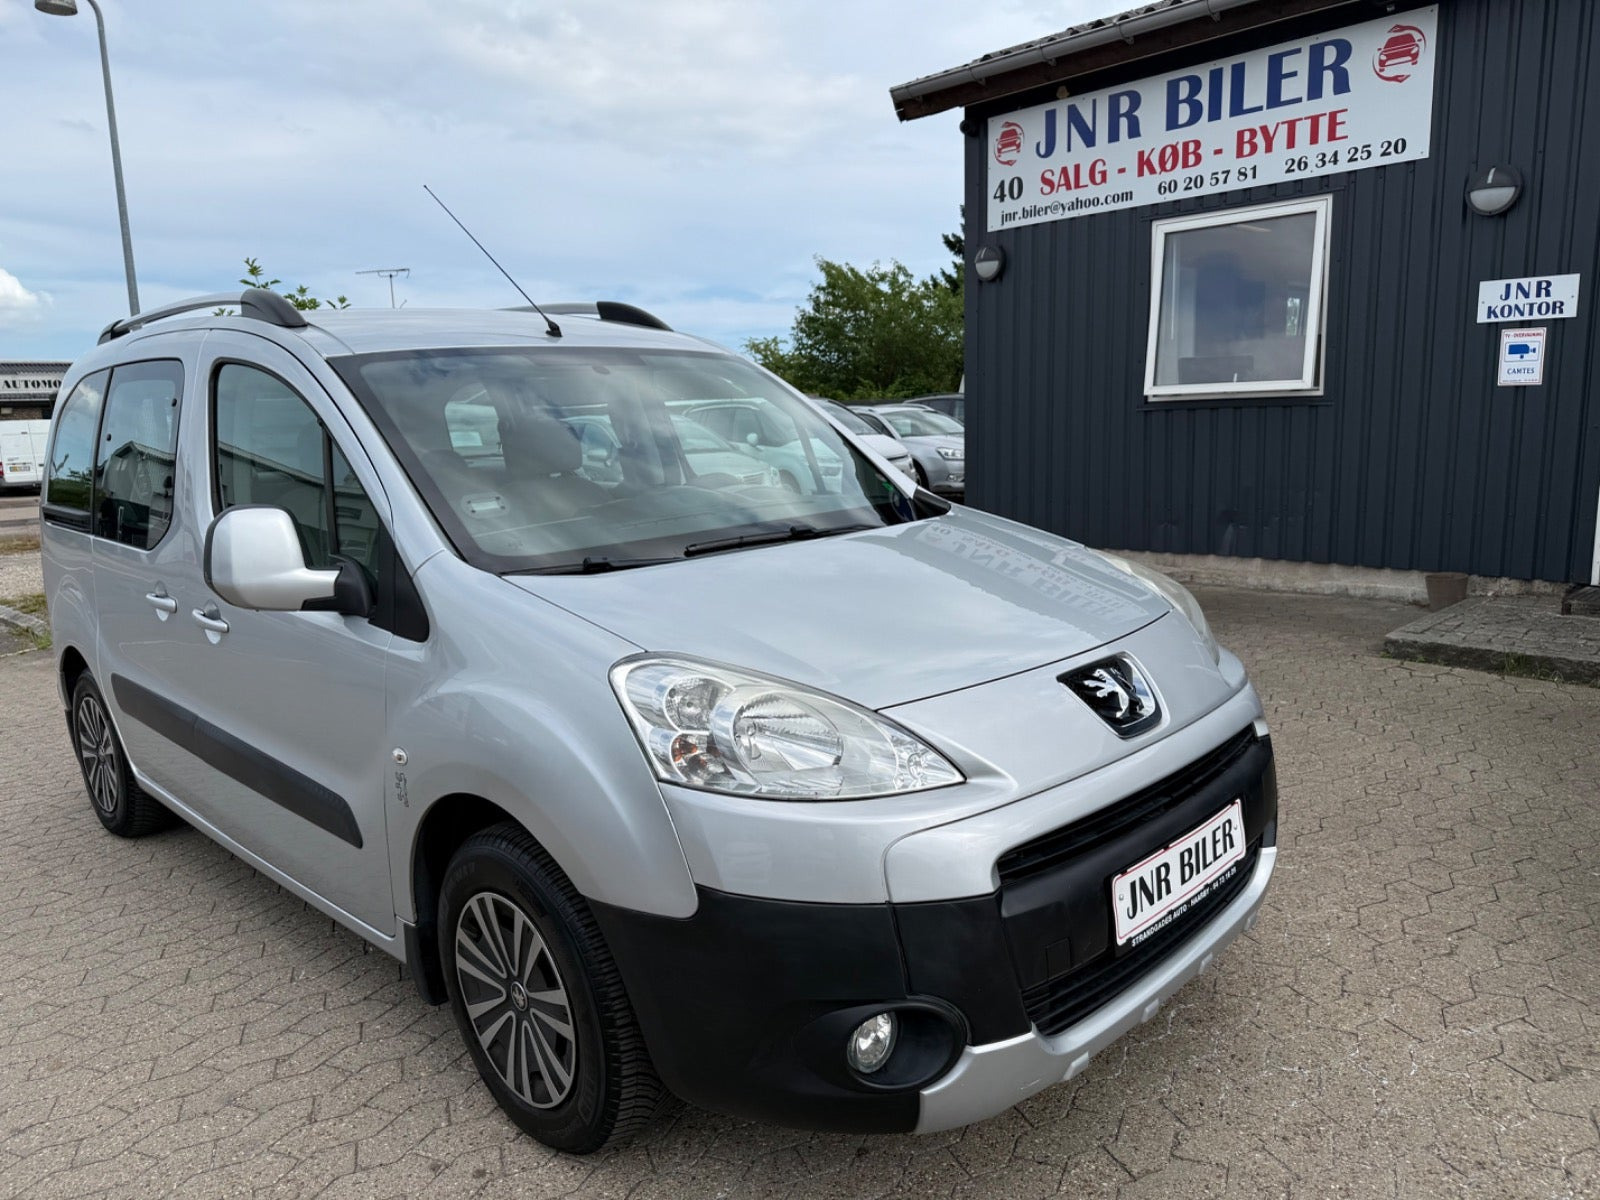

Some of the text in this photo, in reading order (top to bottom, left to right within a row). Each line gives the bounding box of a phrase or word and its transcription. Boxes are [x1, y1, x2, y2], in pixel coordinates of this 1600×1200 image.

[1035, 38, 1353, 159] JNR BILER
[1040, 108, 1349, 196] SALG - KØB - BYTTE
[1284, 137, 1407, 174] 26 34 25 20
[993, 176, 1024, 203] 40
[1158, 164, 1257, 196] 60 20 57 81
[1000, 190, 1134, 226] jnr.biler@yahoo.com
[1500, 279, 1553, 301] JNR
[1486, 300, 1565, 320] KONTOR
[1126, 818, 1235, 920] JNR BILER
[1173, 904, 1188, 919] AUTO
